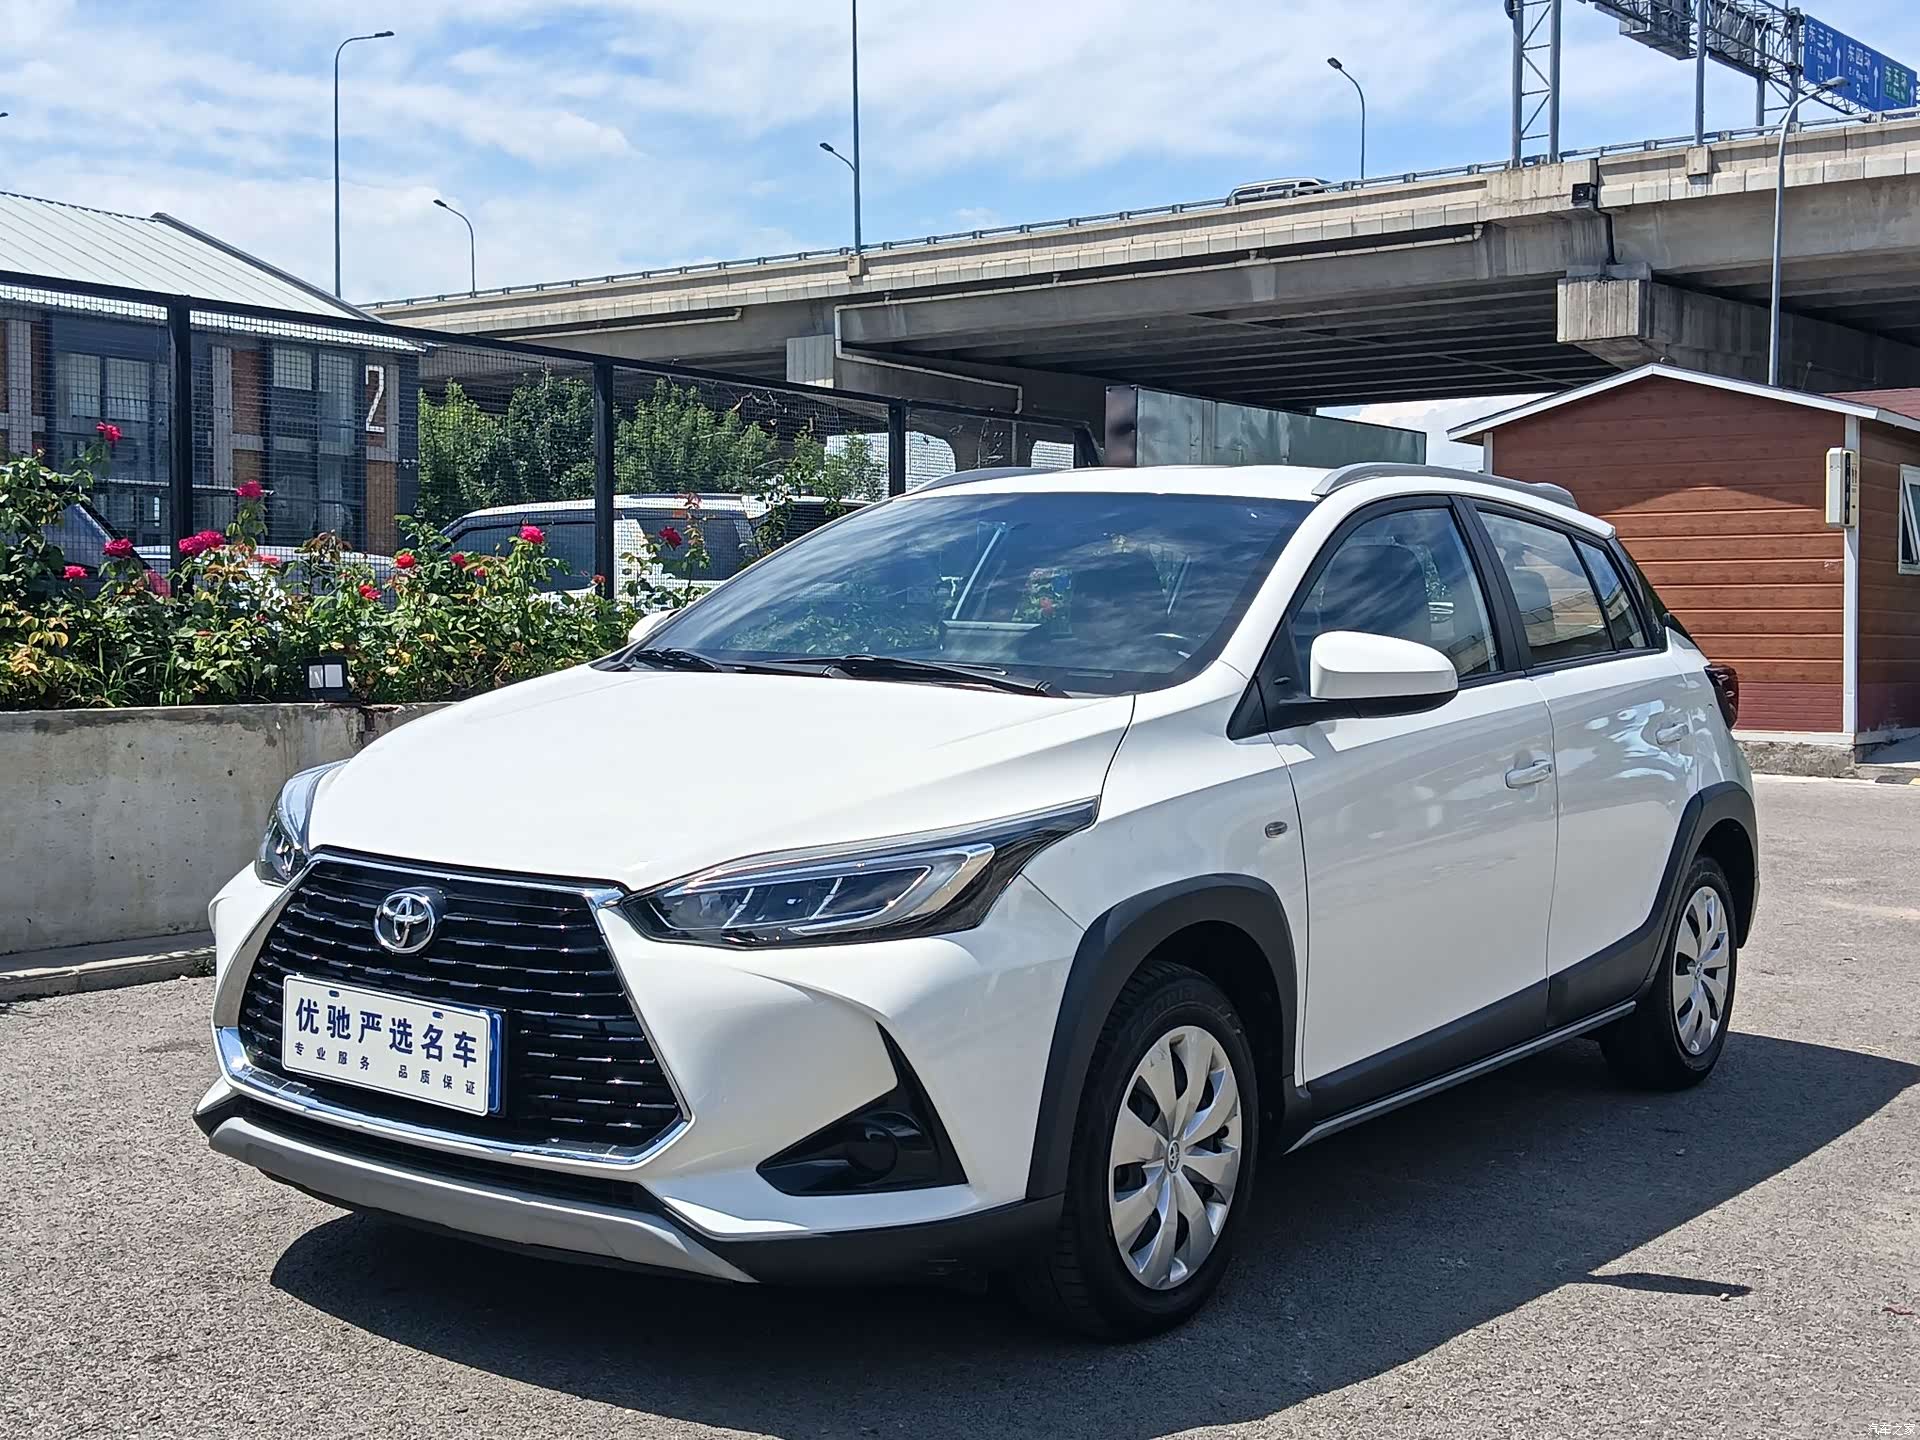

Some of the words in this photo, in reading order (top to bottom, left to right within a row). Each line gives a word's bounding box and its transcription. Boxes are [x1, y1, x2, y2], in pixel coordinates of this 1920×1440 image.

[365, 364, 385, 433] 2
[295, 998, 477, 1068] 优驰严选名车
[294, 1041, 370, 1071] 专业服务
[398, 1064, 476, 1095] 品质保证
